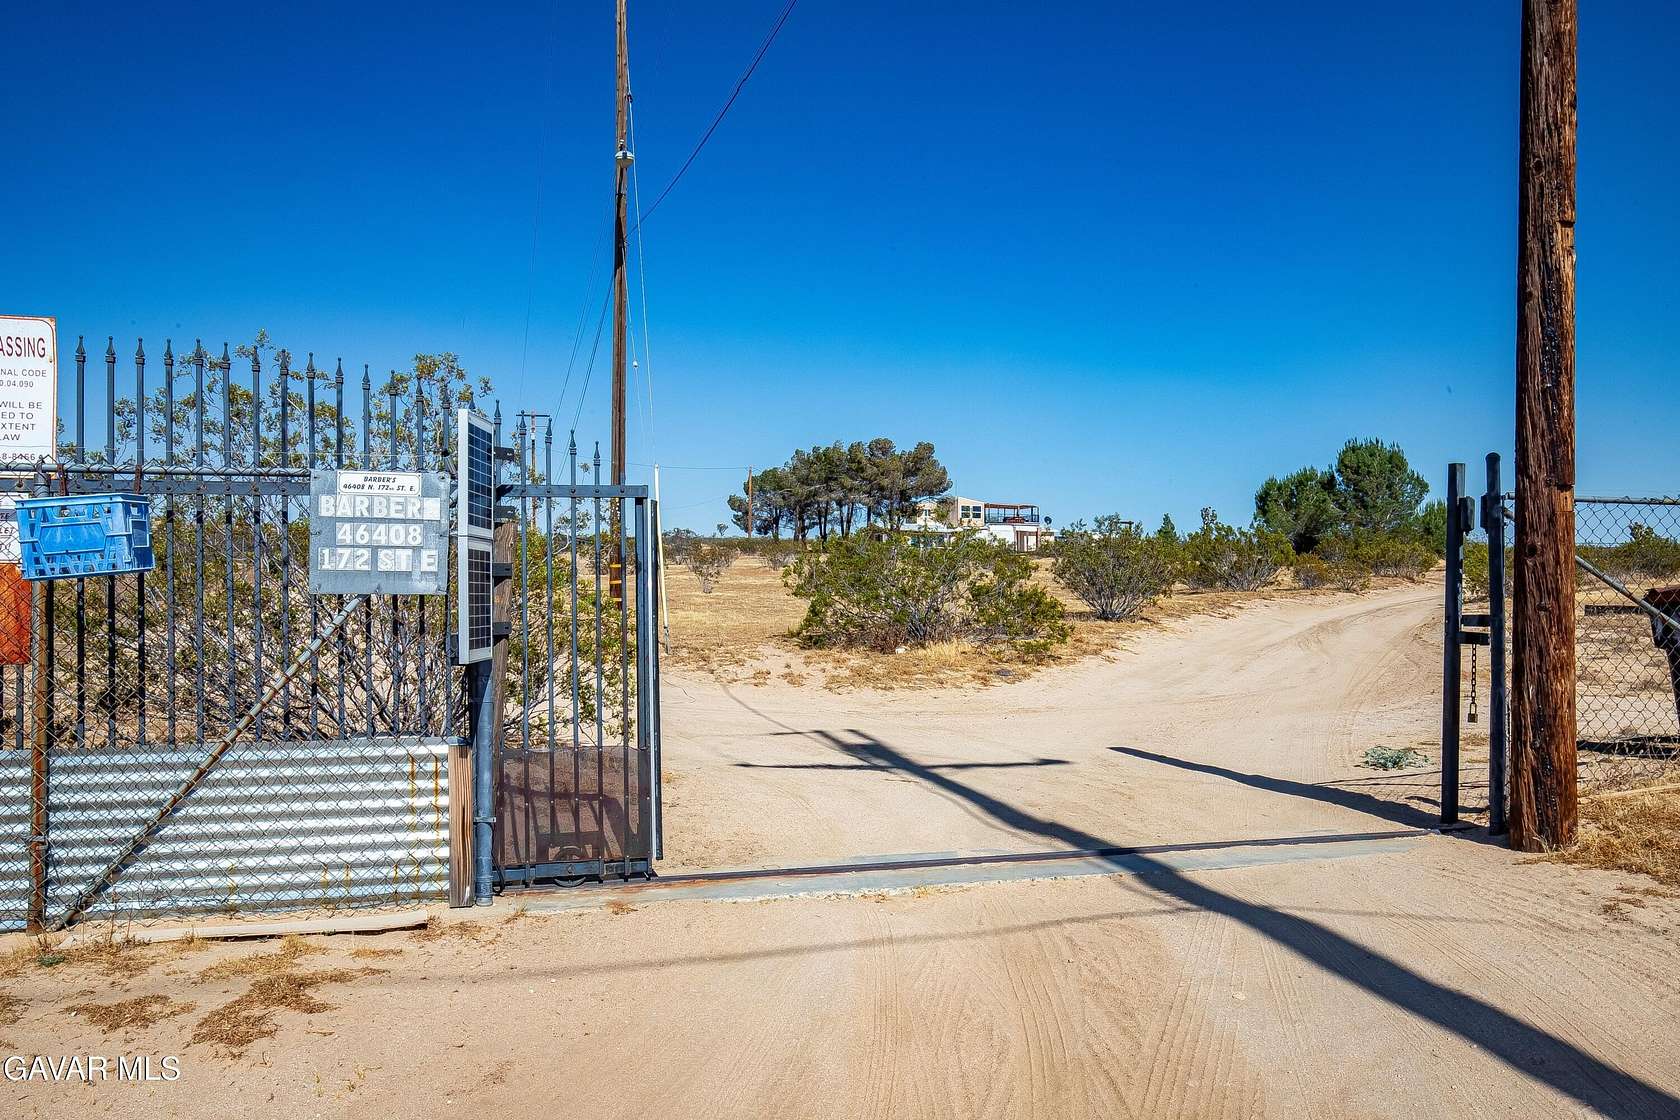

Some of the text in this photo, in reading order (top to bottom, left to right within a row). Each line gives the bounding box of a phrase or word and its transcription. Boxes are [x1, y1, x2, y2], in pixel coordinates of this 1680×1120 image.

[21, 368, 47, 378] CODE
[0, 401, 43, 410] WILL BE
[1, 411, 34, 420] ED TO
[0, 422, 37, 431] XTENT
[336, 522, 422, 546] 46408
[321, 548, 438, 571] 172 ST E
